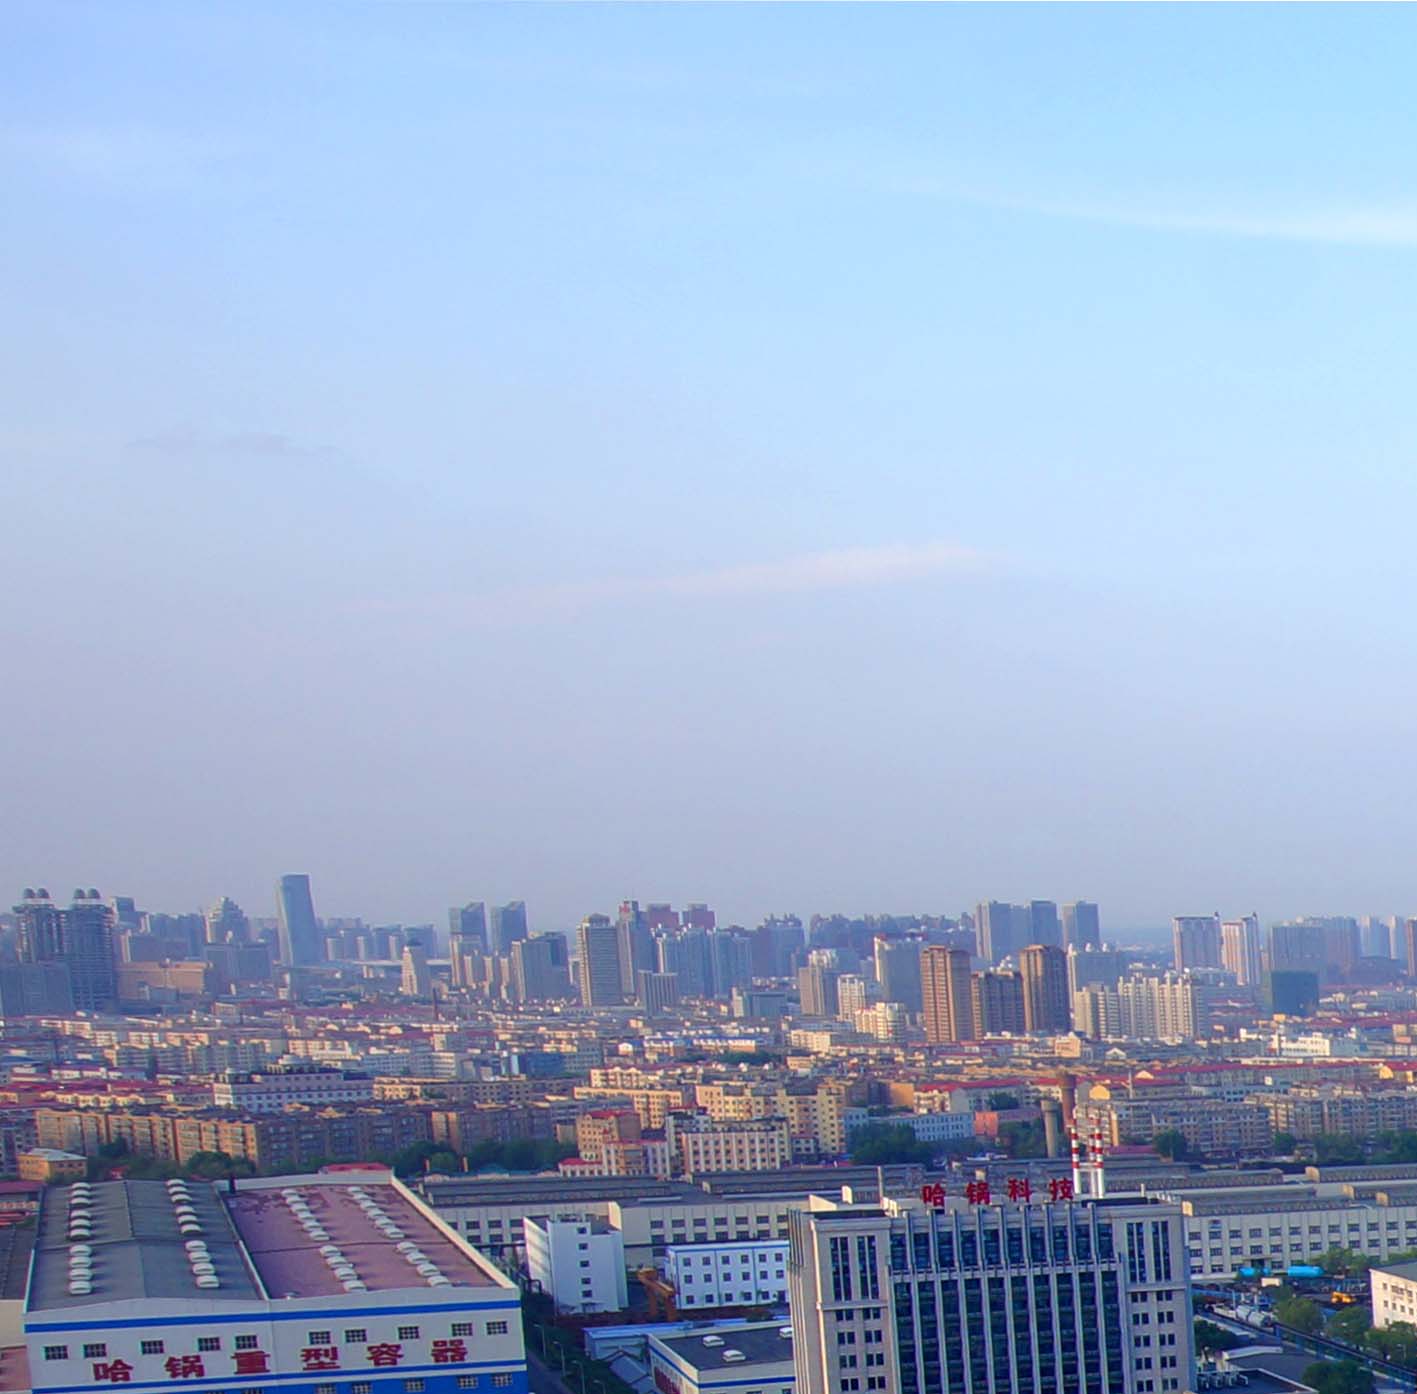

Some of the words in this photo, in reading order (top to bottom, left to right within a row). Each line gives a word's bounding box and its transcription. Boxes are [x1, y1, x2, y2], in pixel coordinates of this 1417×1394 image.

[922, 1177, 1074, 1207] 哈锅科技
[93, 1339, 469, 1382] 哈锅重型容器
